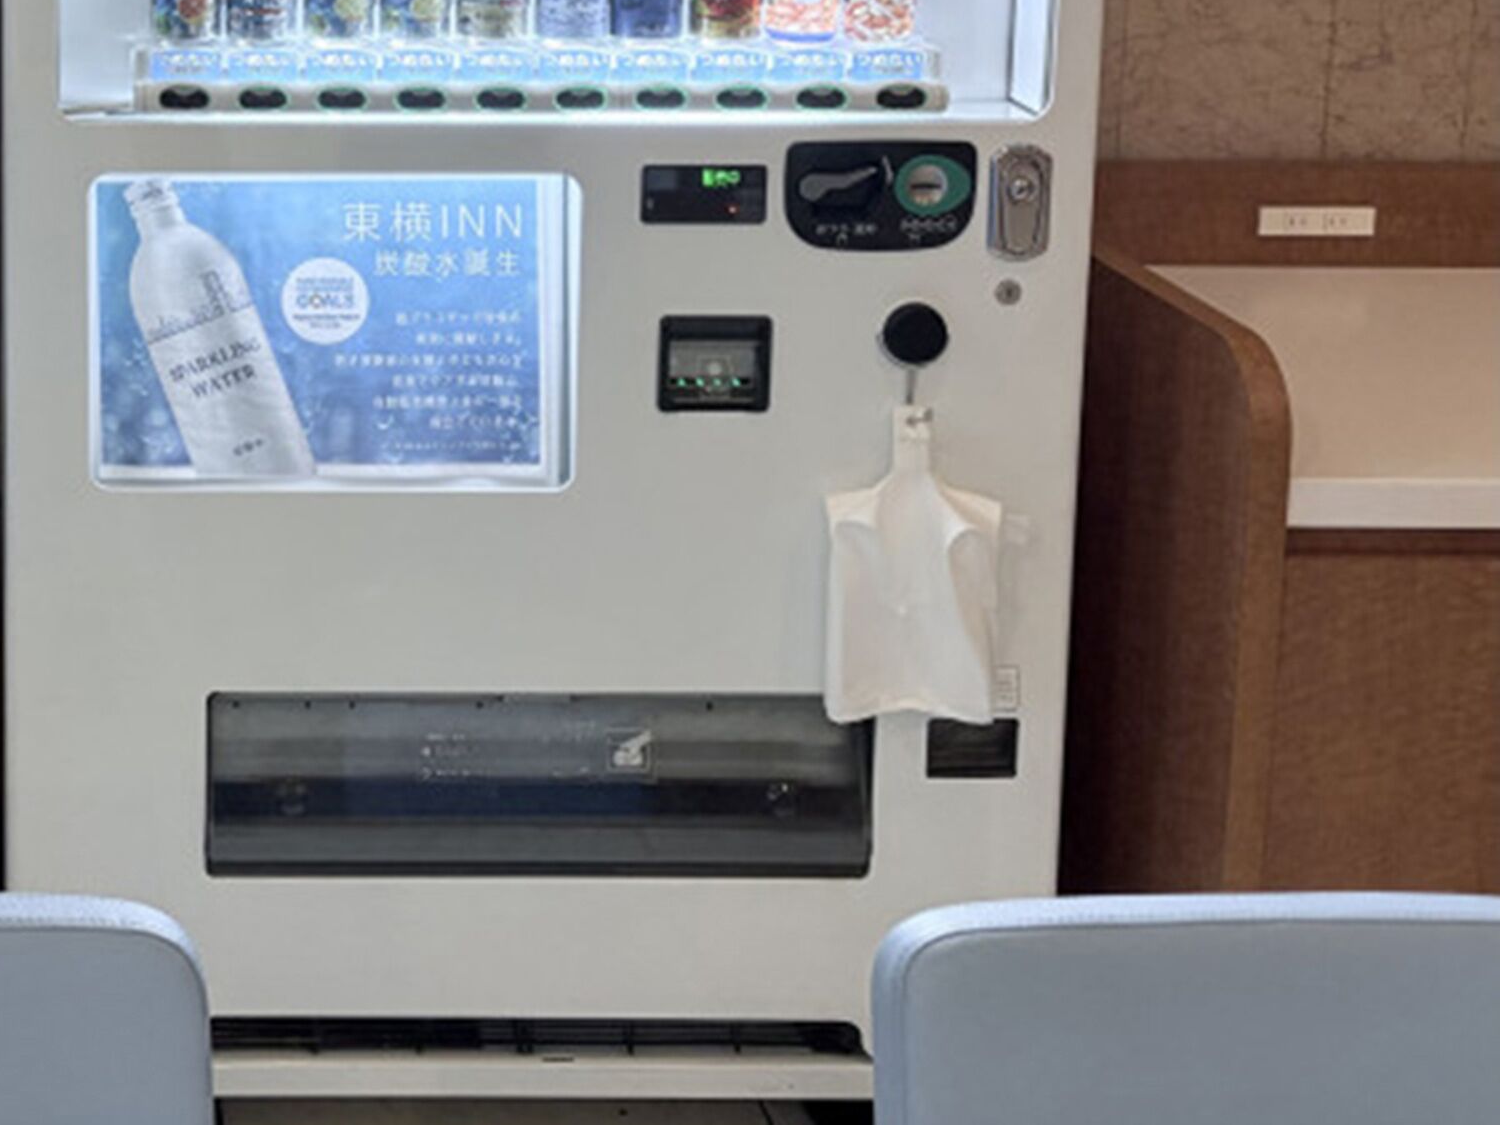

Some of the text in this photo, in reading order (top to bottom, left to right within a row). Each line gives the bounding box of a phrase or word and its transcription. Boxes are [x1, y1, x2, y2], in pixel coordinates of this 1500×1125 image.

[342, 202, 523, 242] 東横INN
[168, 337, 261, 384] SPARKLING
[190, 364, 256, 399] WATER
